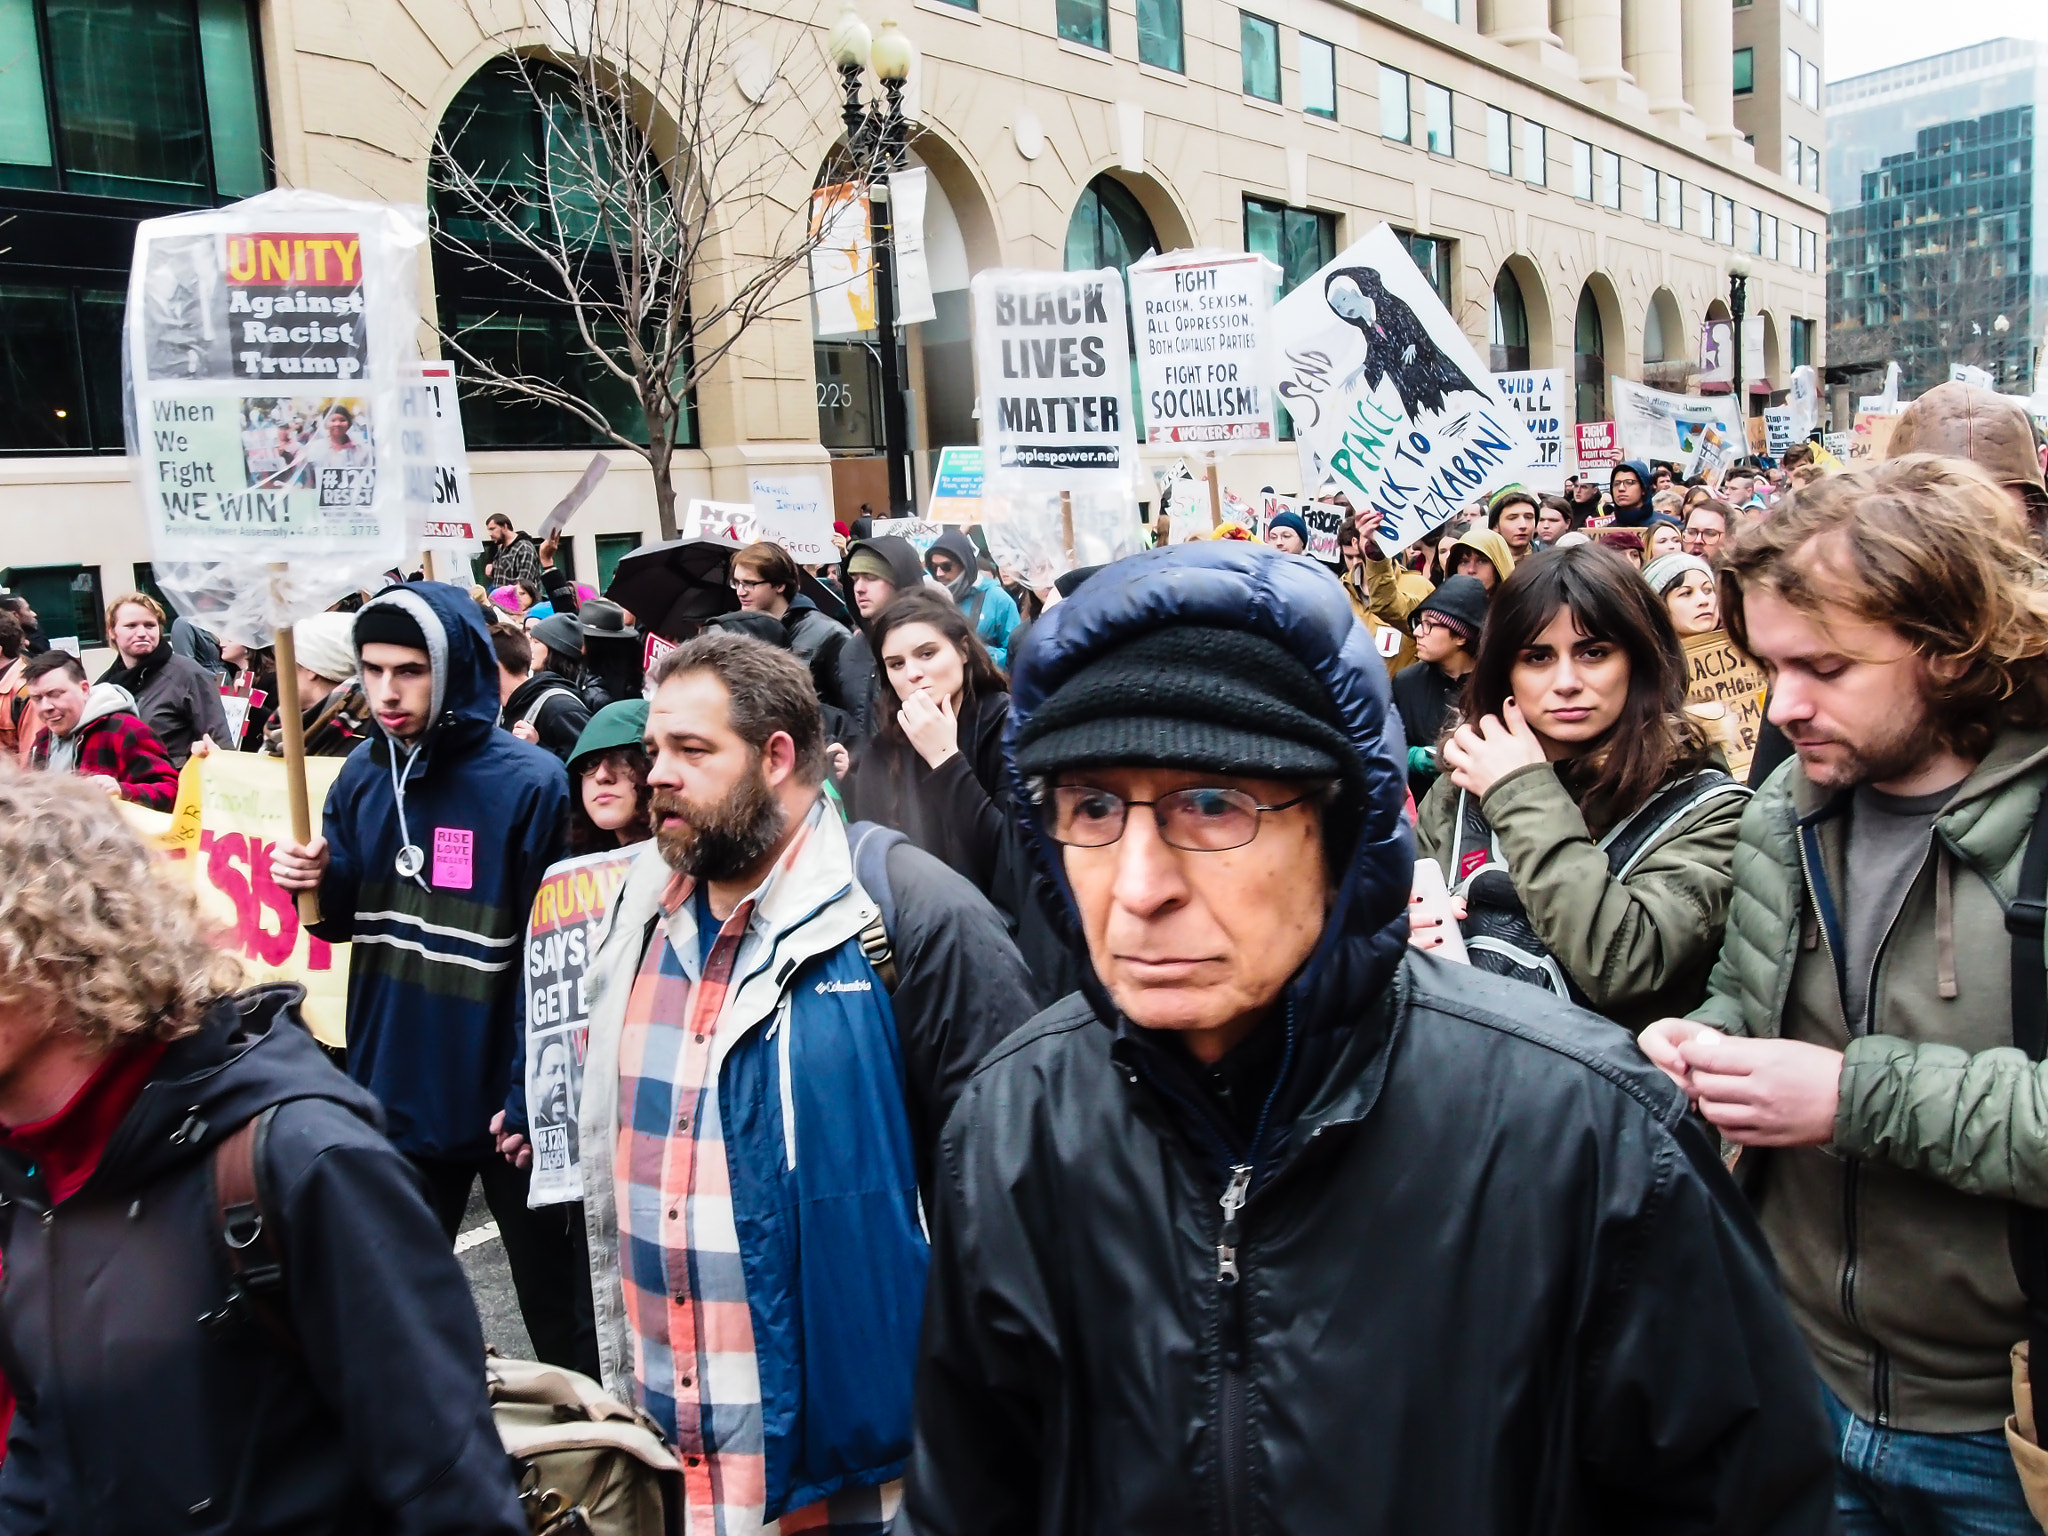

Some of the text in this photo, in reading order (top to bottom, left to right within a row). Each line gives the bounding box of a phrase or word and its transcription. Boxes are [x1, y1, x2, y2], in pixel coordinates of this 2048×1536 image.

[229, 240, 360, 281] UNITY
[1174, 269, 1217, 293] FIGHT
[229, 291, 365, 318] Against
[995, 283, 1108, 326] BLACK
[243, 321, 356, 344] Racist
[1148, 318, 1169, 334] ALL
[1149, 338, 1173, 355] BOTH
[1219, 333, 1256, 349] PARTIES
[240, 351, 360, 379] Trump
[1001, 336, 1106, 379] LIVES
[1166, 363, 1238, 385] FIGHT FOR
[1498, 376, 1551, 394] BUILD A
[152, 400, 214, 422] When
[1000, 396, 1119, 433] MATTER
[1151, 386, 1260, 420] SOCIALISM!
[1508, 395, 1551, 411] ALL
[1526, 418, 1559, 433] UND
[1582, 424, 1608, 438] FIGHT
[154, 430, 188, 452] We
[1330, 393, 1403, 494] PENCE
[1394, 431, 1432, 468] TO
[1580, 436, 1611, 449] TRUMP
[1016, 448, 1119, 465] oplespower.net
[159, 461, 215, 488] Fight
[1413, 410, 1520, 531] AZKABAN!
[161, 492, 211, 521] WE
[217, 492, 291, 522] WIN!
[1370, 466, 1421, 541] BACK
[777, 537, 821, 554] GREED
[437, 844, 469, 855] LOVE
[438, 832, 470, 844] RISE
[530, 928, 586, 978] SAYS
[826, 979, 872, 992] Columbia
[532, 979, 576, 1026] GET
